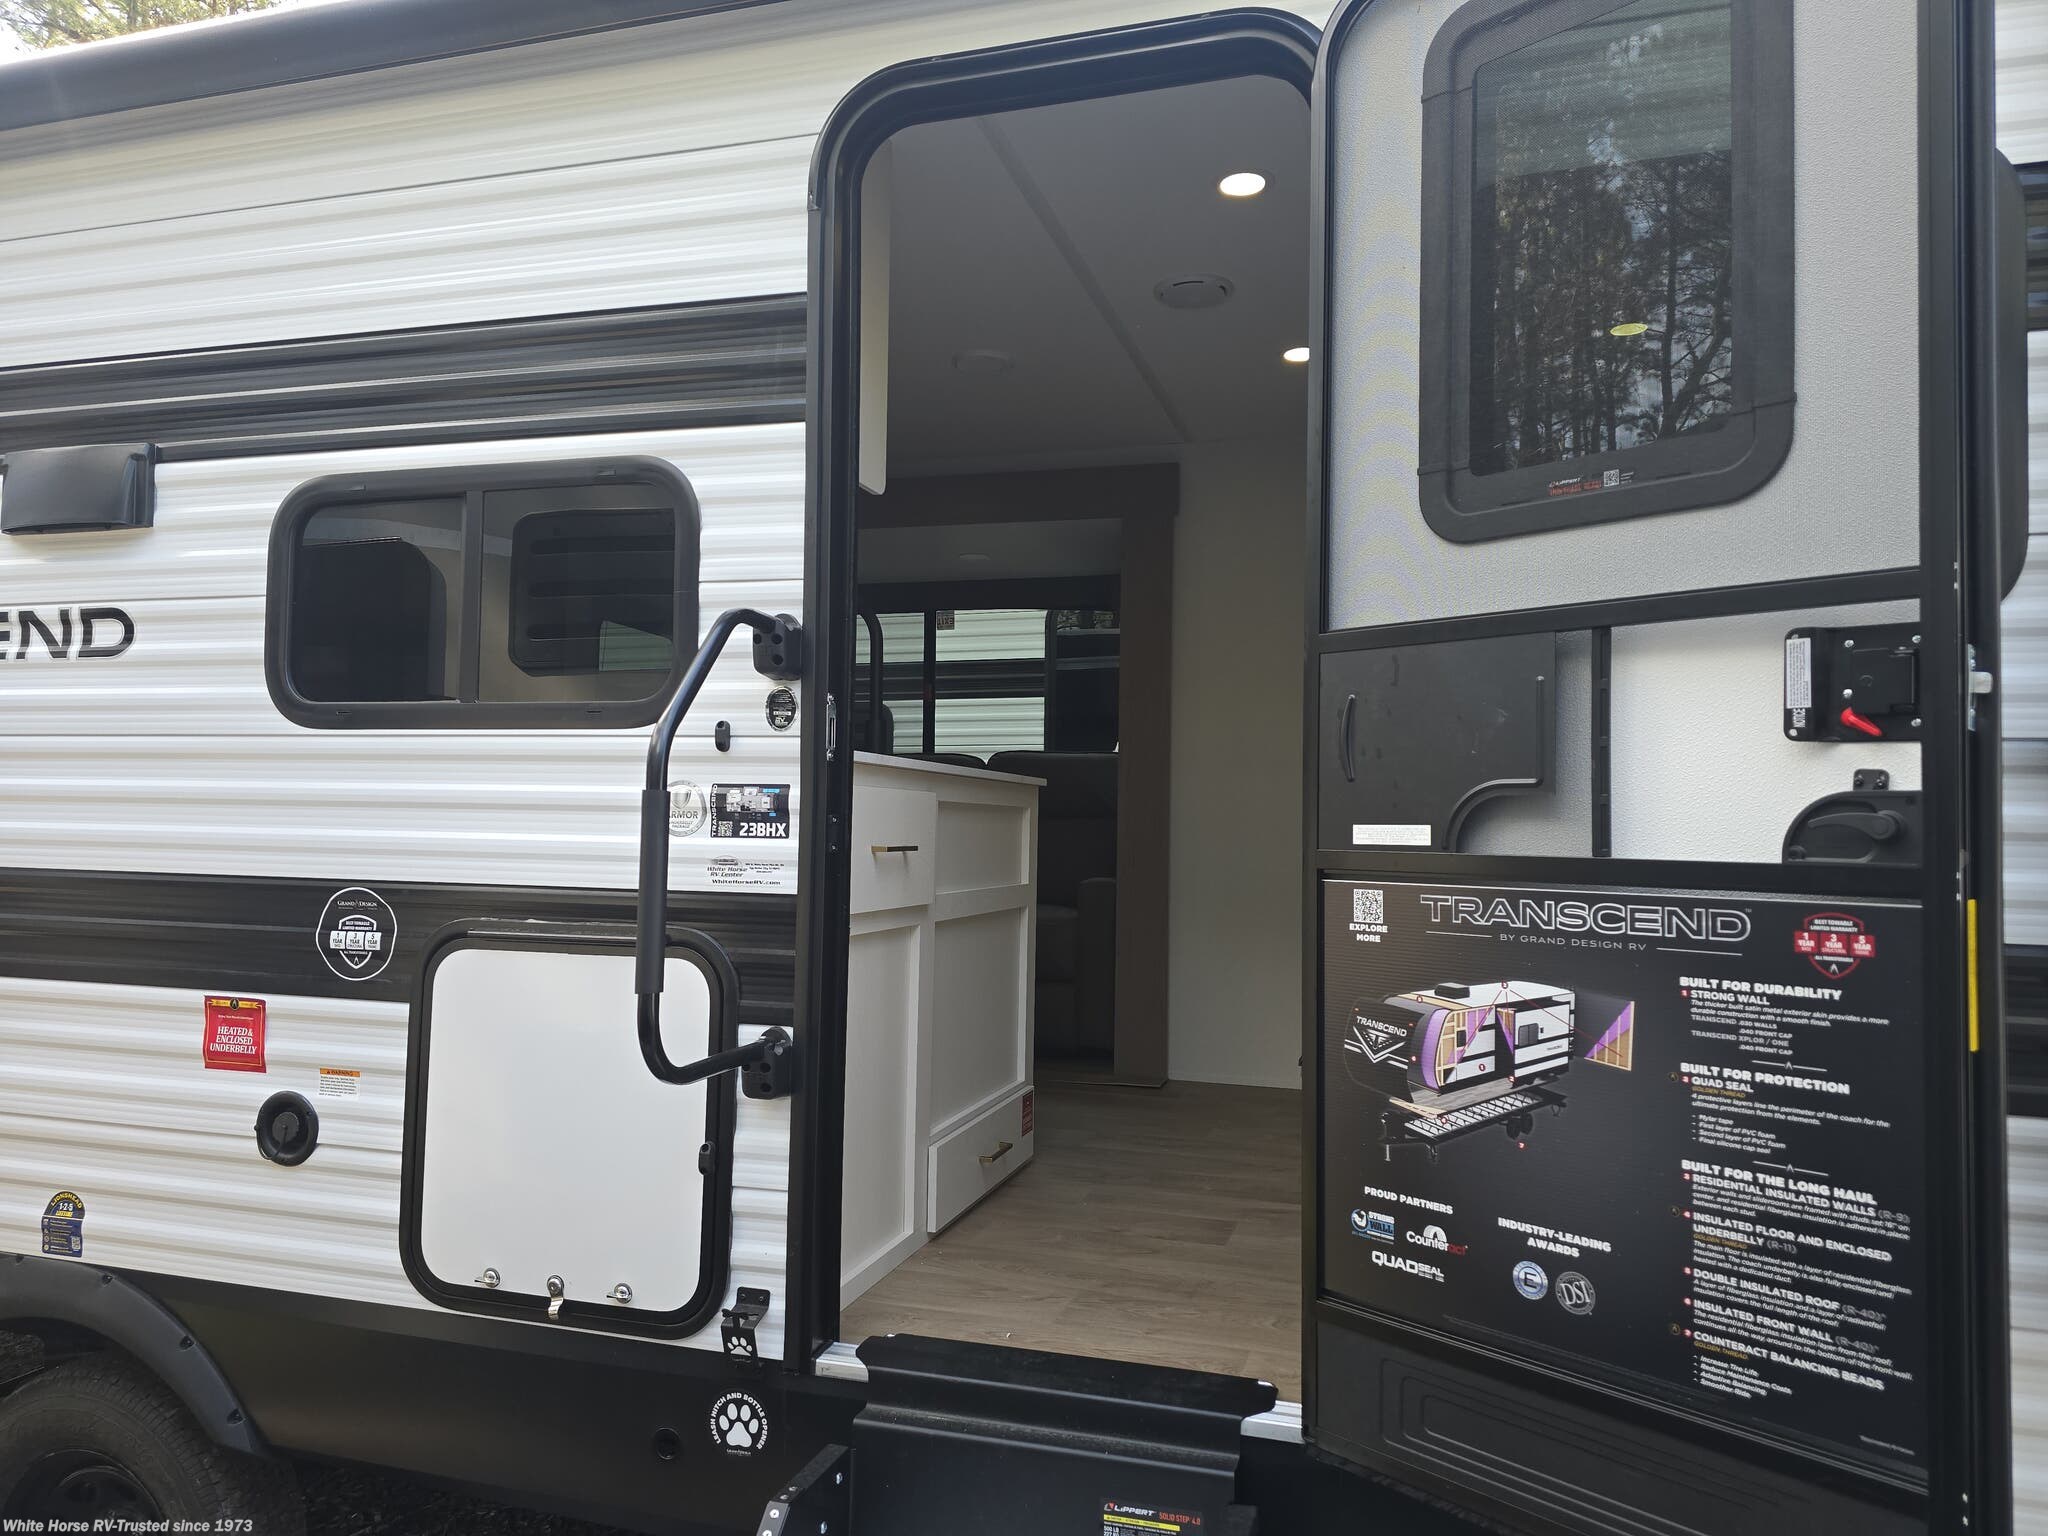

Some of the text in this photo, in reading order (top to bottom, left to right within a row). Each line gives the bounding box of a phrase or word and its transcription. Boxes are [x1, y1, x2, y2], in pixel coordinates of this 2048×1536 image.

[740, 822, 787, 837] 23BHX
[1349, 923, 1388, 933] EXPLORE
[1803, 932, 1808, 940] 1
[1356, 934, 1380, 942] MORE
[1520, 936, 1566, 945] GRAND
[1572, 939, 1622, 950] DESIGN
[1629, 943, 1647, 951] RV
[1830, 934, 1837, 942] 3
[1854, 942, 1871, 950] YEAR
[1858, 935, 1866, 944] 5
[1680, 976, 1842, 1000] BUILT FOR DURABILITY
[1690, 990, 1735, 1002] STRONG
[1737, 994, 1770, 1005] WALL
[1691, 1014, 1737, 1025] TRANSCEND
[1717, 1010, 1758, 1019] construction
[1760, 1014, 1775, 1022] with
[1782, 1016, 1809, 1024] smooth
[1762, 1006, 1782, 1014] metal
[1828, 1014, 1861, 1022] provides
[217, 1026, 253, 1036] HEATED &
[1356, 1016, 1407, 1037] TRANSCEND
[1755, 1030, 1777, 1038] FRONT
[216, 1034, 252, 1045] ENCLOSED
[1691, 1030, 1737, 1040] TRANSCEND
[1738, 1036, 1764, 1044] XPLOR
[210, 1042, 257, 1054] UNDERBELLY
[1755, 1046, 1777, 1054] FRONT
[1680, 1062, 1850, 1095] BUILT FOR PROTECTION
[1691, 1076, 1754, 1092] QUAD SEAL
[1681, 1159, 1878, 1206] BUILT FOR THE LONG HAUL
[1364, 1186, 1454, 1214] PROUD PARTNERS
[1692, 1174, 1763, 1195] RESIDENTIAL
[1765, 1188, 1830, 1208] INSULATED
[1832, 1200, 1877, 1217] WALLS
[1370, 1220, 1393, 1234] WALL
[1498, 1217, 1612, 1252] INDUSTRY-LEADING
[1693, 1224, 1764, 1246] UNDERBELLY
[1406, 1230, 1467, 1256] Counteract
[1693, 1212, 1892, 1262] INSULATED FLOOR AND ENCLOSED
[1526, 1237, 1580, 1258] AWARDS
[1524, 1271, 1538, 1289] E
[1694, 1268, 1840, 1310] DOUBLE INSULATED ROOF
[1560, 1280, 1591, 1304] DSI
[1694, 1300, 1834, 1343] INSULATED FRONT WALL
[1694, 1340, 1748, 1360] GOLDEN THREAD
[1694, 1330, 1886, 1391] COUNTERACT BALANCING BEADS
[1700, 1356, 1760, 1378] Increase Tire Life
[1700, 1363, 1792, 1395] Reduce Maintenance Costs
[1700, 1371, 1768, 1397] Adaptive Balancing
[1700, 1378, 1752, 1400] Smoother Ride
[710, 1392, 768, 1450] LEASH HITCH AND BOTTLE OPENER
[1159, 1512, 1175, 1520] SOLID
[1176, 1514, 1190, 1524] STEP
